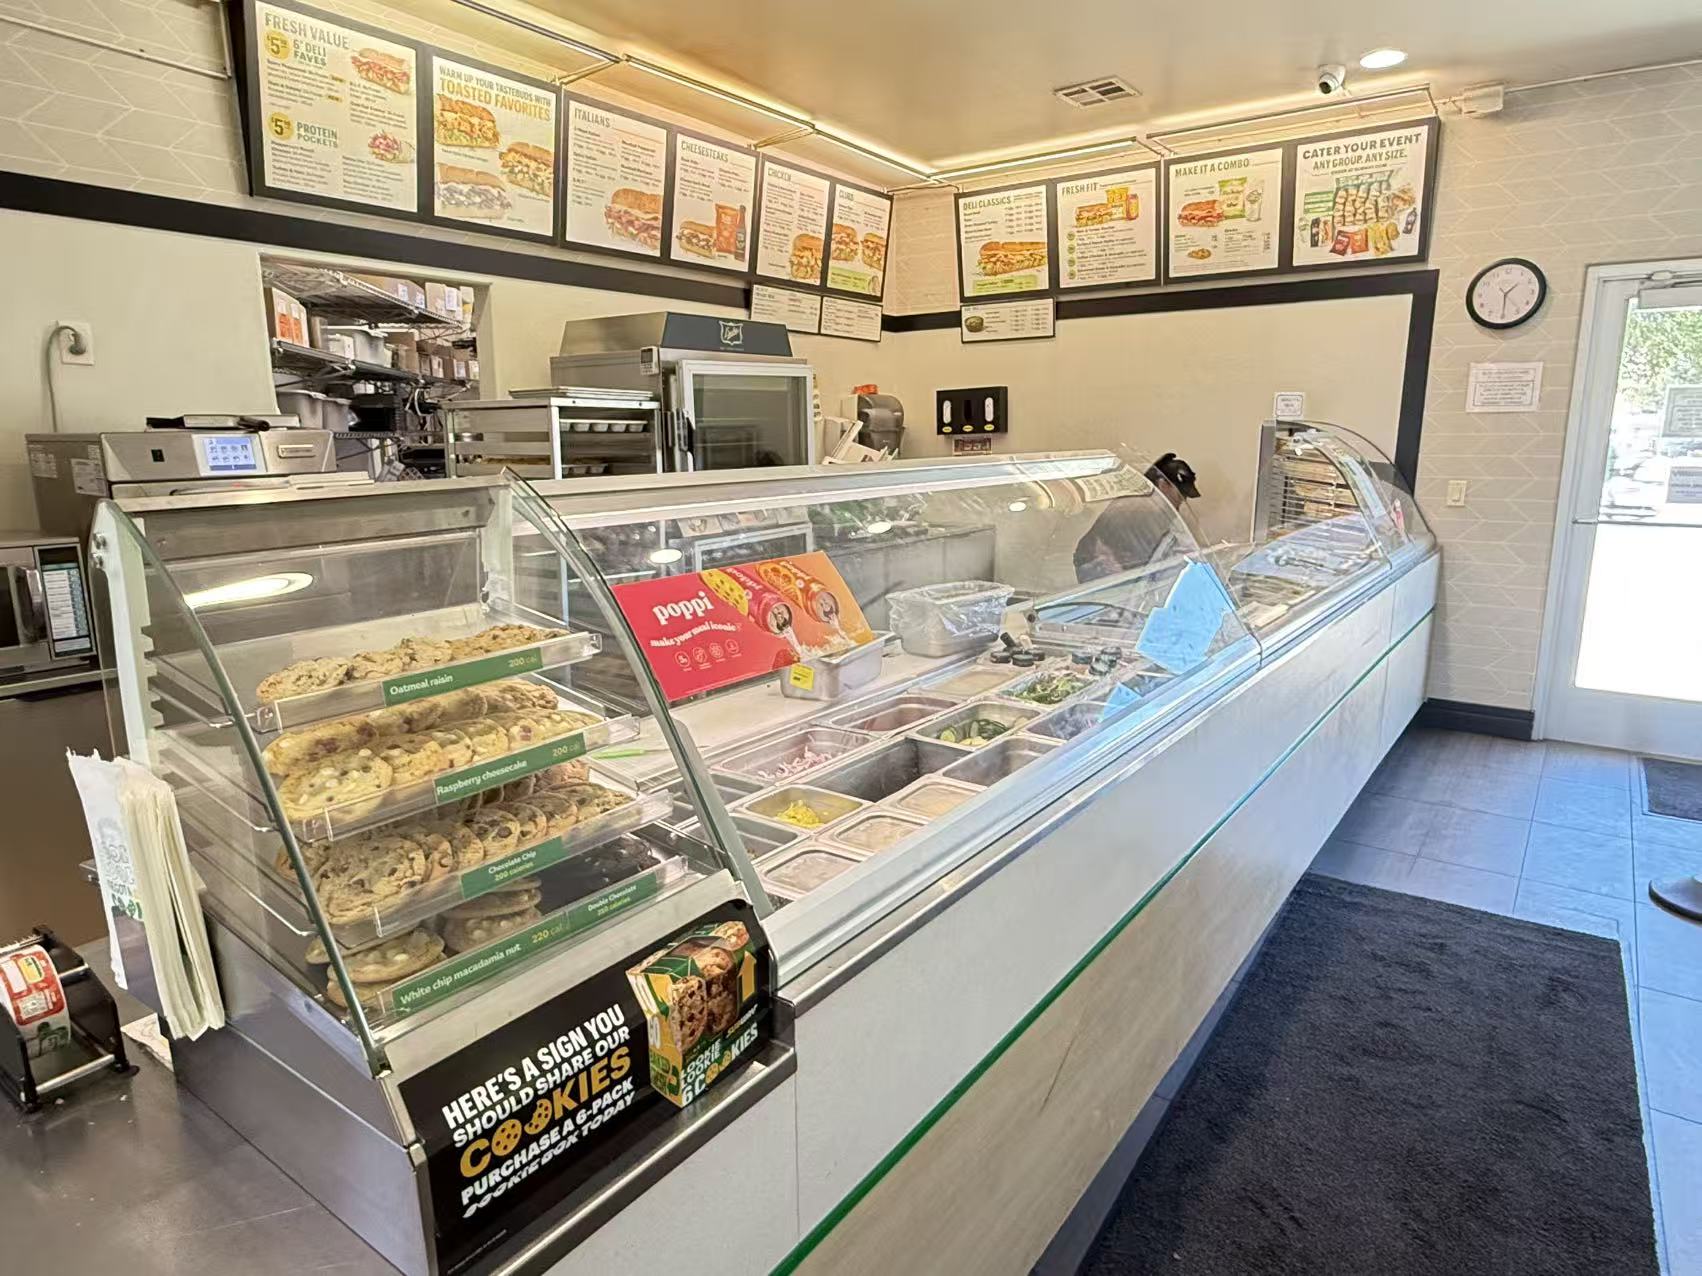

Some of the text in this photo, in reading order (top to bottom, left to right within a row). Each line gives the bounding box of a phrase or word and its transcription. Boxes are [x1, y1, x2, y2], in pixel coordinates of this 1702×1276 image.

[264, 13, 350, 51] FRESH VALUE
[293, 51, 327, 67] FAVES
[306, 43, 327, 59] DELI
[440, 65, 551, 108] WARM UP YOUR TASTEBUDS WITH
[440, 77, 493, 105] TOASTED
[495, 93, 551, 122] FAVORITES
[574, 107, 611, 129] ITALIANS
[297, 121, 338, 140] PROTEIN
[297, 133, 339, 149] POCKETS
[681, 140, 729, 163] CHEESESTEAKS
[1302, 133, 1422, 161] CATER YOUR EVENT
[1175, 157, 1250, 177] MAKE IT A COMBO
[1312, 148, 1409, 171] ANY GROUP. ANY SIZE.
[1062, 182, 1099, 197] FRESH FIT
[963, 195, 1012, 211] DELI CLASSICS
[652, 590, 714, 626] poppi
[650, 636, 675, 647] make
[673, 631, 692, 646] your
[508, 656, 525, 669] 200
[389, 673, 454, 695] Oatmeal raisin
[552, 745, 568, 758] 200
[436, 759, 528, 796] Raspberry cheesecake
[488, 850, 537, 875] Chocolate Chip
[494, 870, 509, 882] 200
[531, 924, 564, 944] 220 cal
[400, 943, 522, 1005] White chip macadamia nut
[442, 1003, 625, 1129] HERE'S A SIGN YOU
[453, 1085, 535, 1148] SHOULD
[534, 1046, 595, 1096] SHARE
[594, 1025, 631, 1058] OUR
[683, 1086, 695, 1104] 6
[459, 1045, 632, 1179] COOKIES
[580, 1090, 636, 1143] TODAY
[460, 1075, 635, 1206] PURCHASE A 6-PACK
